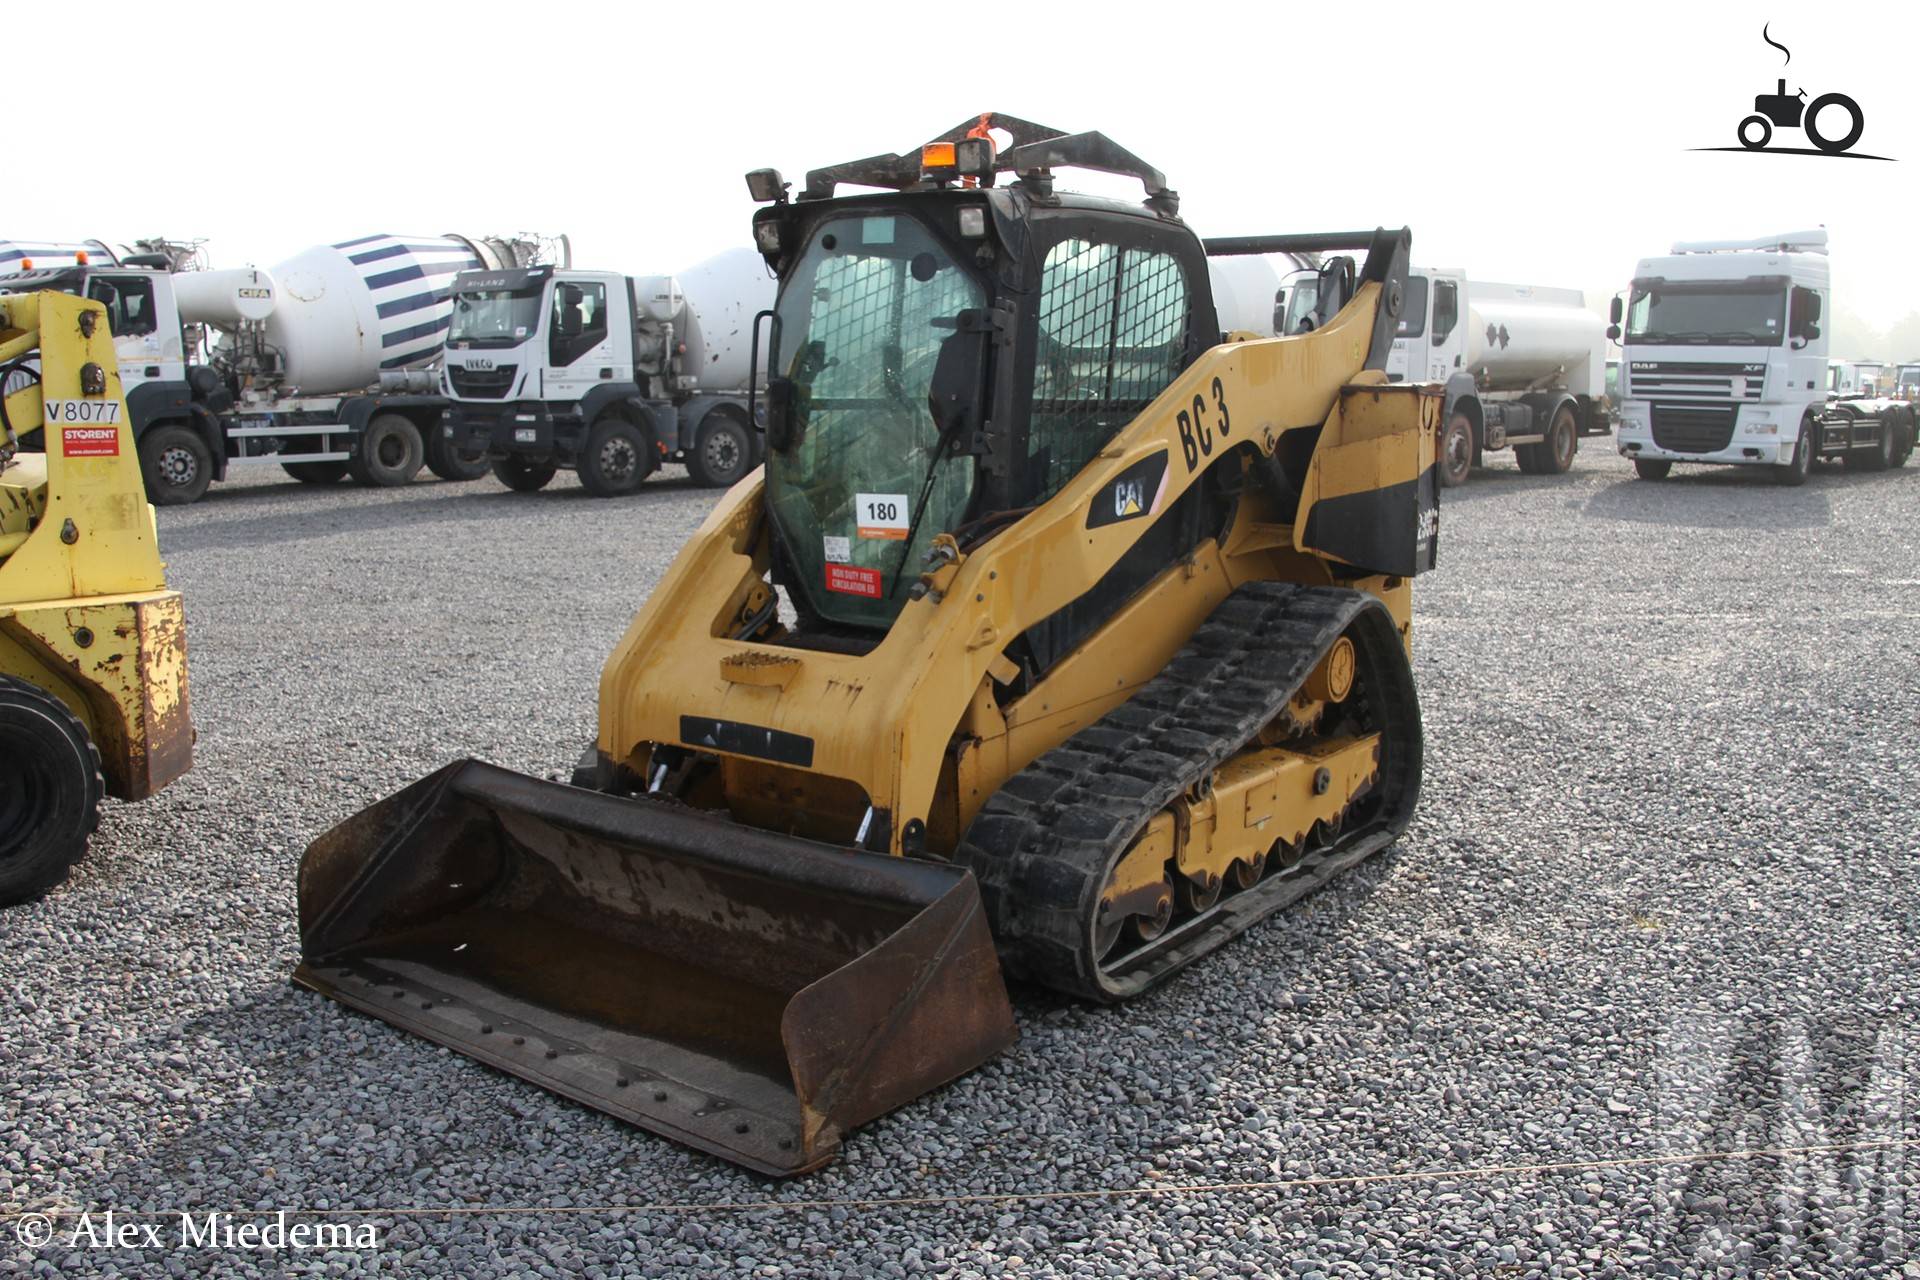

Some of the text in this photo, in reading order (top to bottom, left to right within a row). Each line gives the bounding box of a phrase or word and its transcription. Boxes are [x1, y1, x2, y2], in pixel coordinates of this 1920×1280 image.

[467, 278, 506, 288] HI-LAND
[240, 288, 270, 298] CIFA
[465, 359, 493, 369] IVECO
[1743, 364, 1764, 372] XF
[46, 402, 119, 424] V 8077
[1176, 376, 1230, 474] BC 3
[64, 429, 116, 440] STORENT
[1115, 477, 1146, 517] CAT
[868, 503, 897, 521] 180
[832, 568, 873, 583] NON DUTY FREE
[832, 578, 866, 592] CIRCULATION
